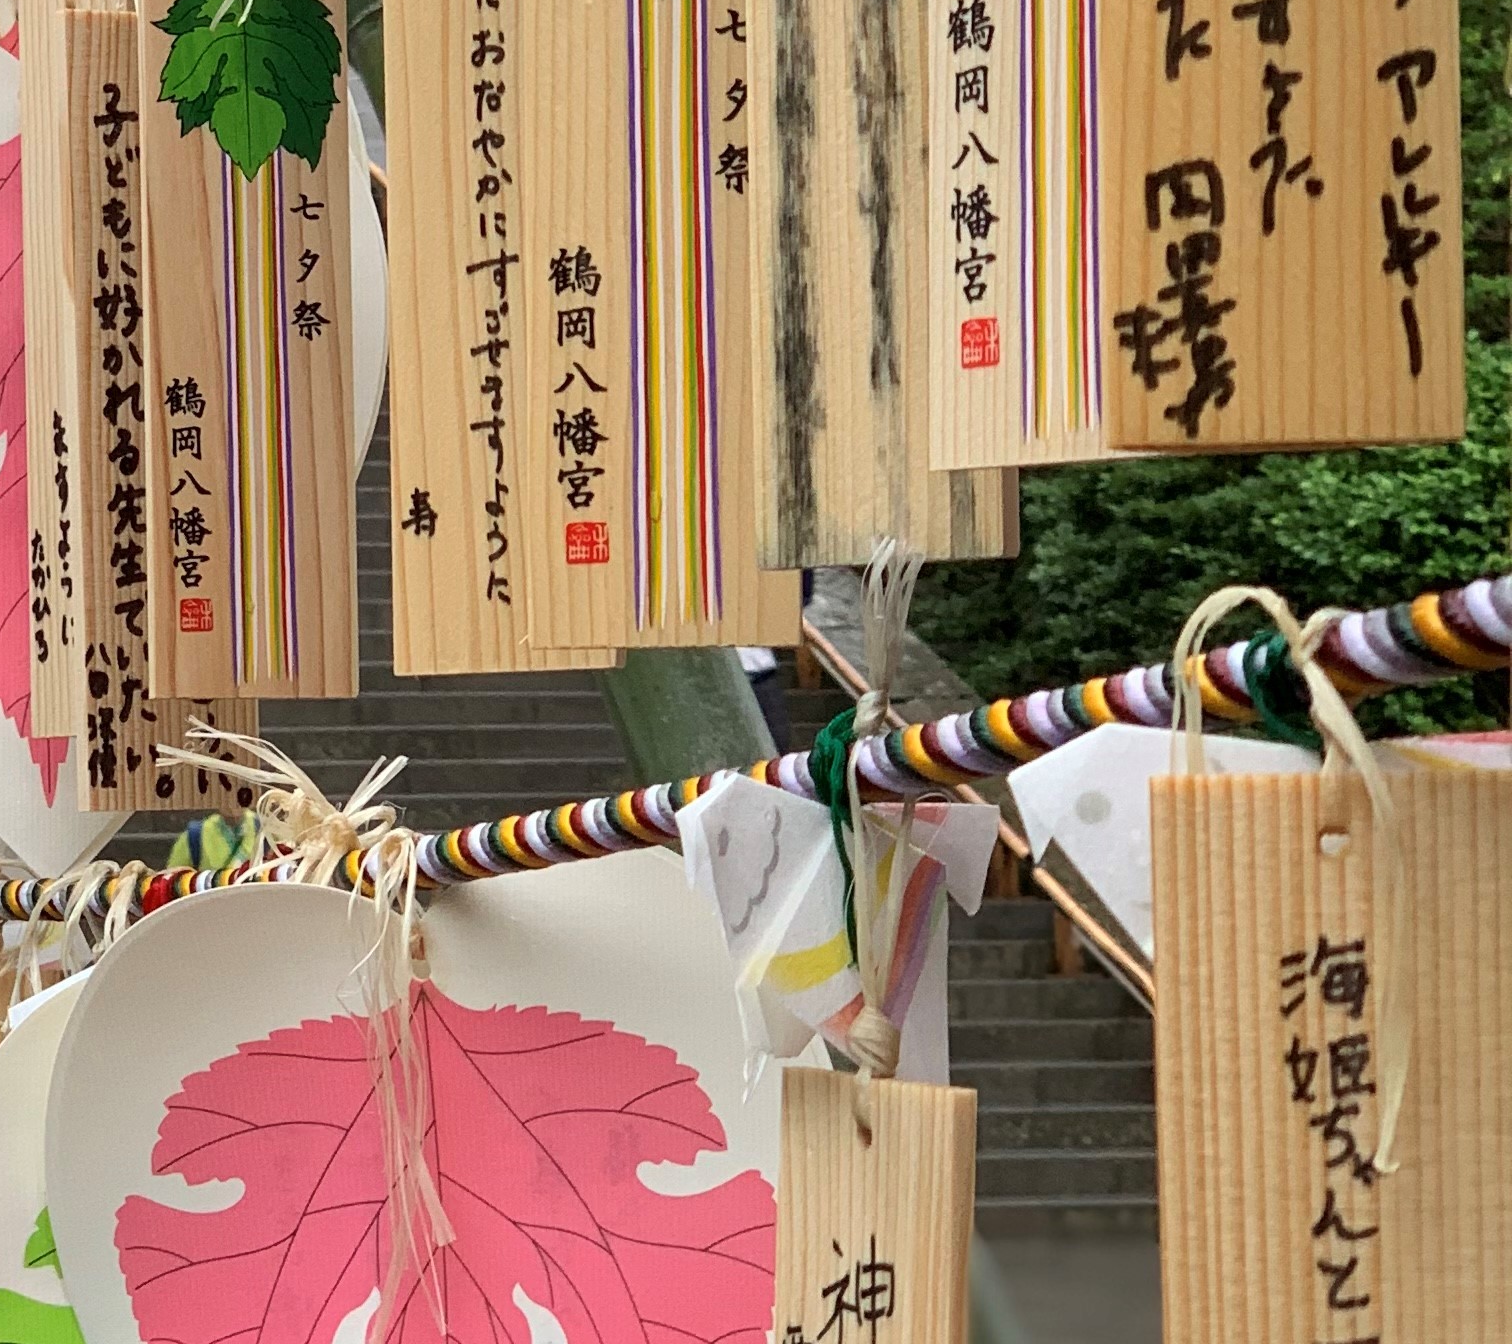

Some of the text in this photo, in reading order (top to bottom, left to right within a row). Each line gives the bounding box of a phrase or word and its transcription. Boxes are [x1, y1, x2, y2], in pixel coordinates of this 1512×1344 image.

[714, 8, 750, 195] 七夕祭
[290, 192, 332, 340] 七夕祭
[548, 245, 610, 511] 鶴岡八幡宮
[164, 376, 213, 589] 鶴岡八幡宮
